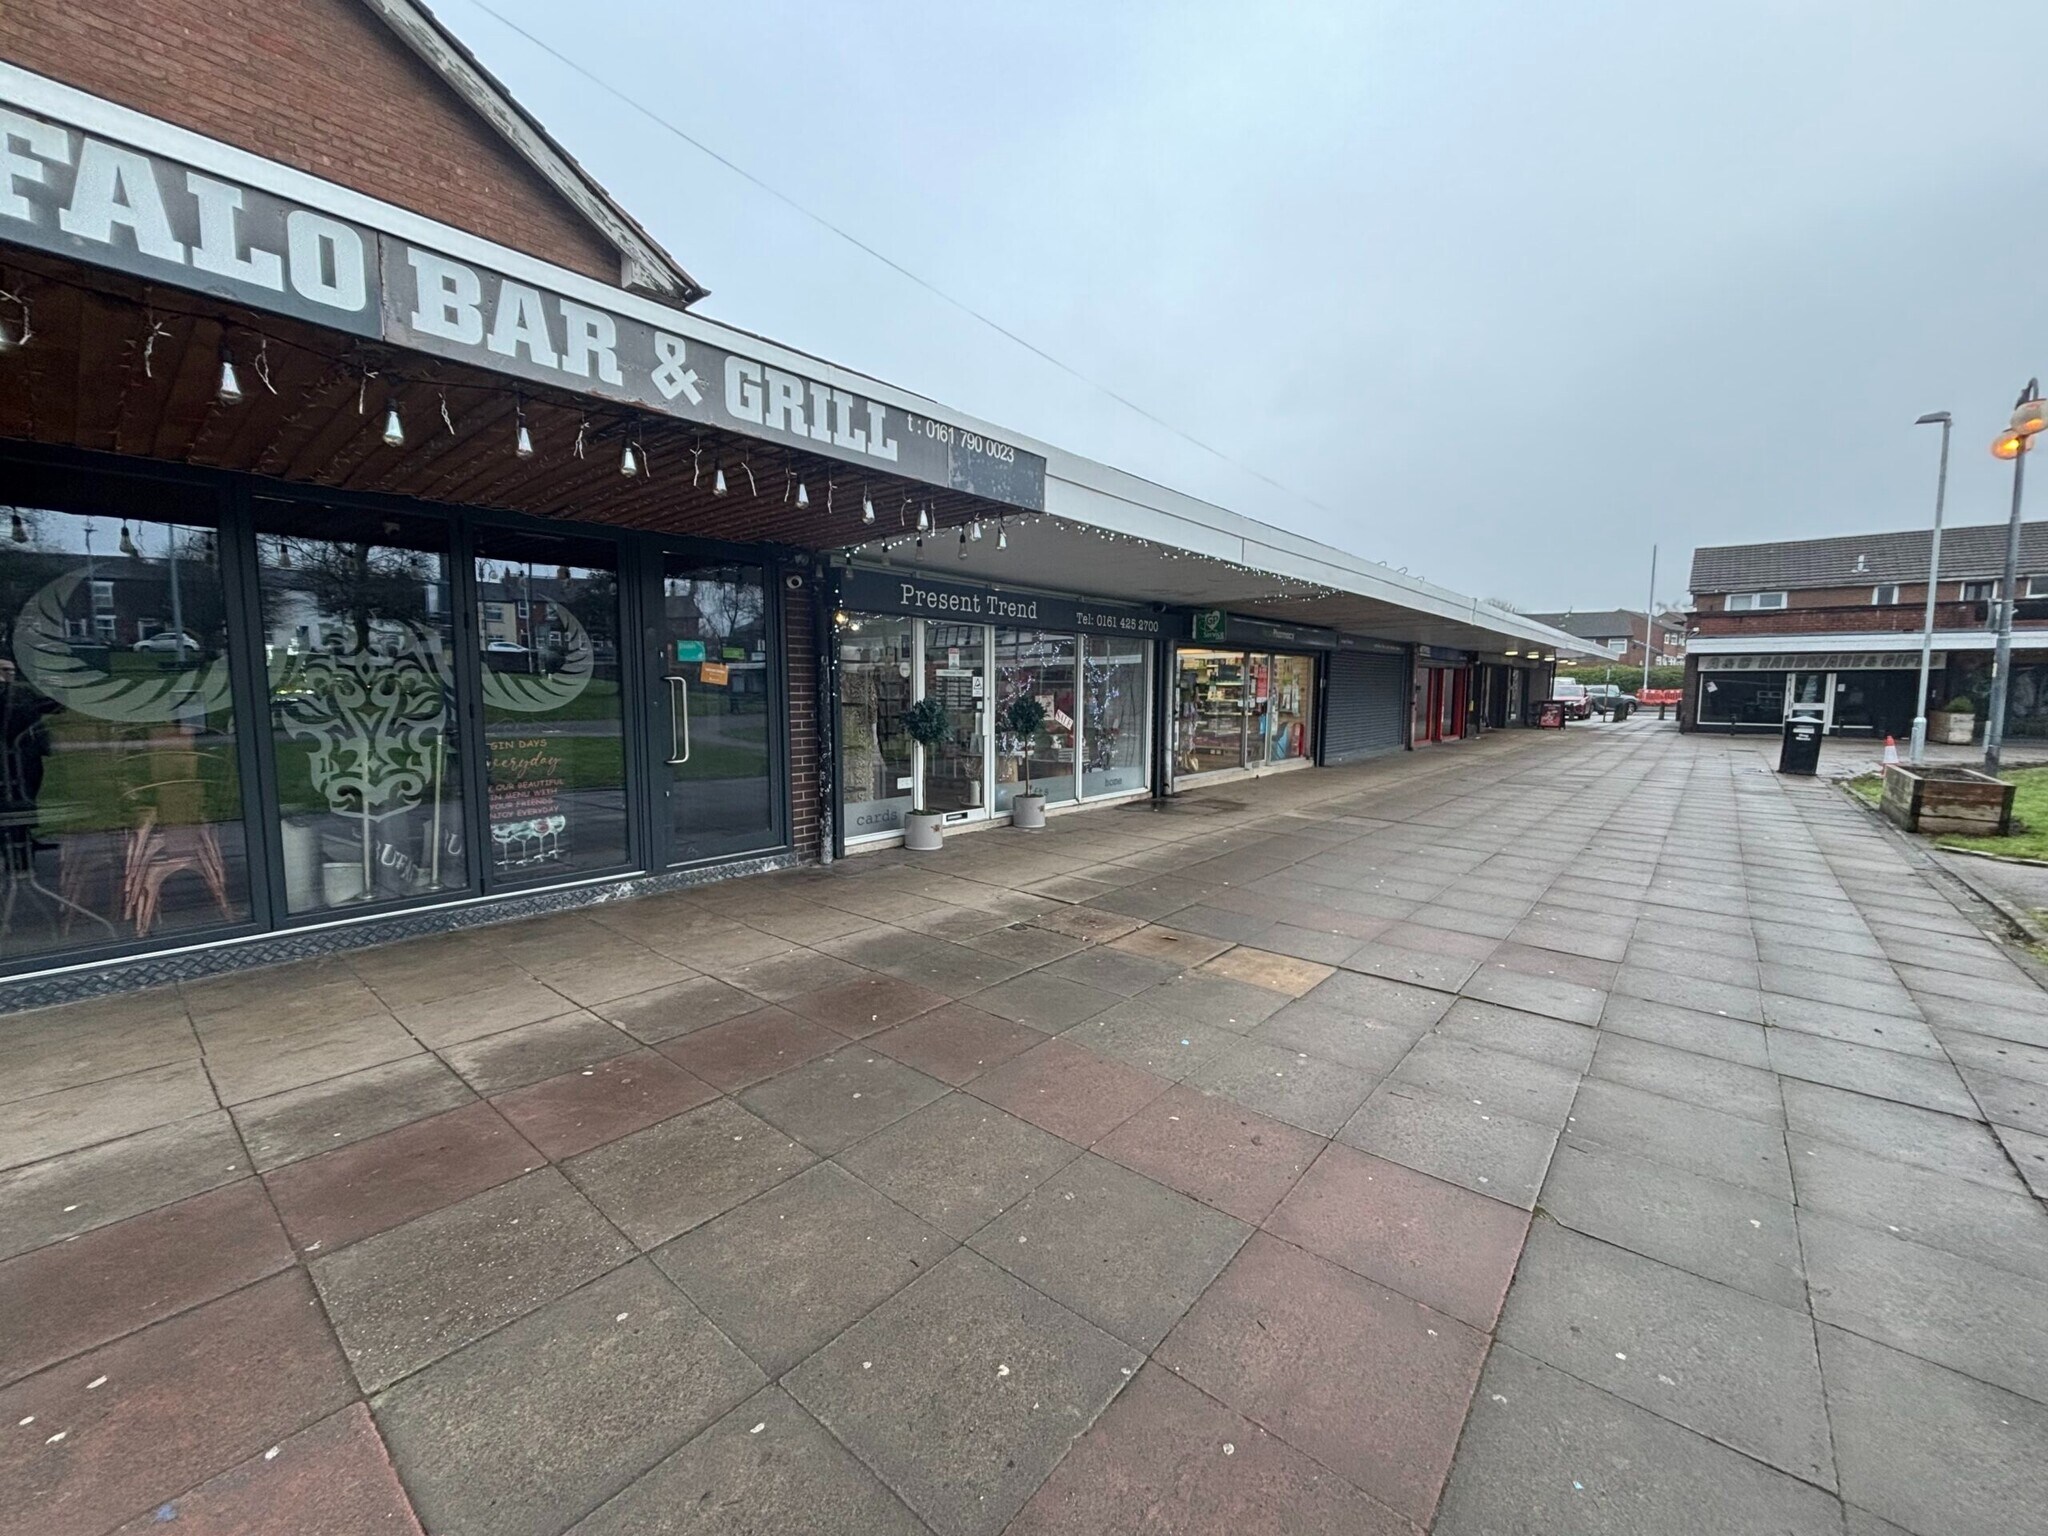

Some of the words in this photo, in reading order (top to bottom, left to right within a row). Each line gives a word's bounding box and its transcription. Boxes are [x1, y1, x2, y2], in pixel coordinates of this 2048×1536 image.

[407, 247, 623, 386] BAR
[651, 331, 702, 406] &
[724, 355, 897, 462] GRILL
[926, 420, 954, 444] 0161
[960, 431, 983, 453] 790
[986, 440, 1016, 463] 0023
[900, 583, 980, 613] Present
[987, 595, 1037, 619] Trend
[1076, 612, 1094, 626] Tel:
[1096, 614, 1117, 628] 0161
[1120, 617, 1137, 630] 425
[1138, 619, 1159, 632] 2700
[519, 739, 547, 749] DAYS
[857, 810, 898, 826] cards
